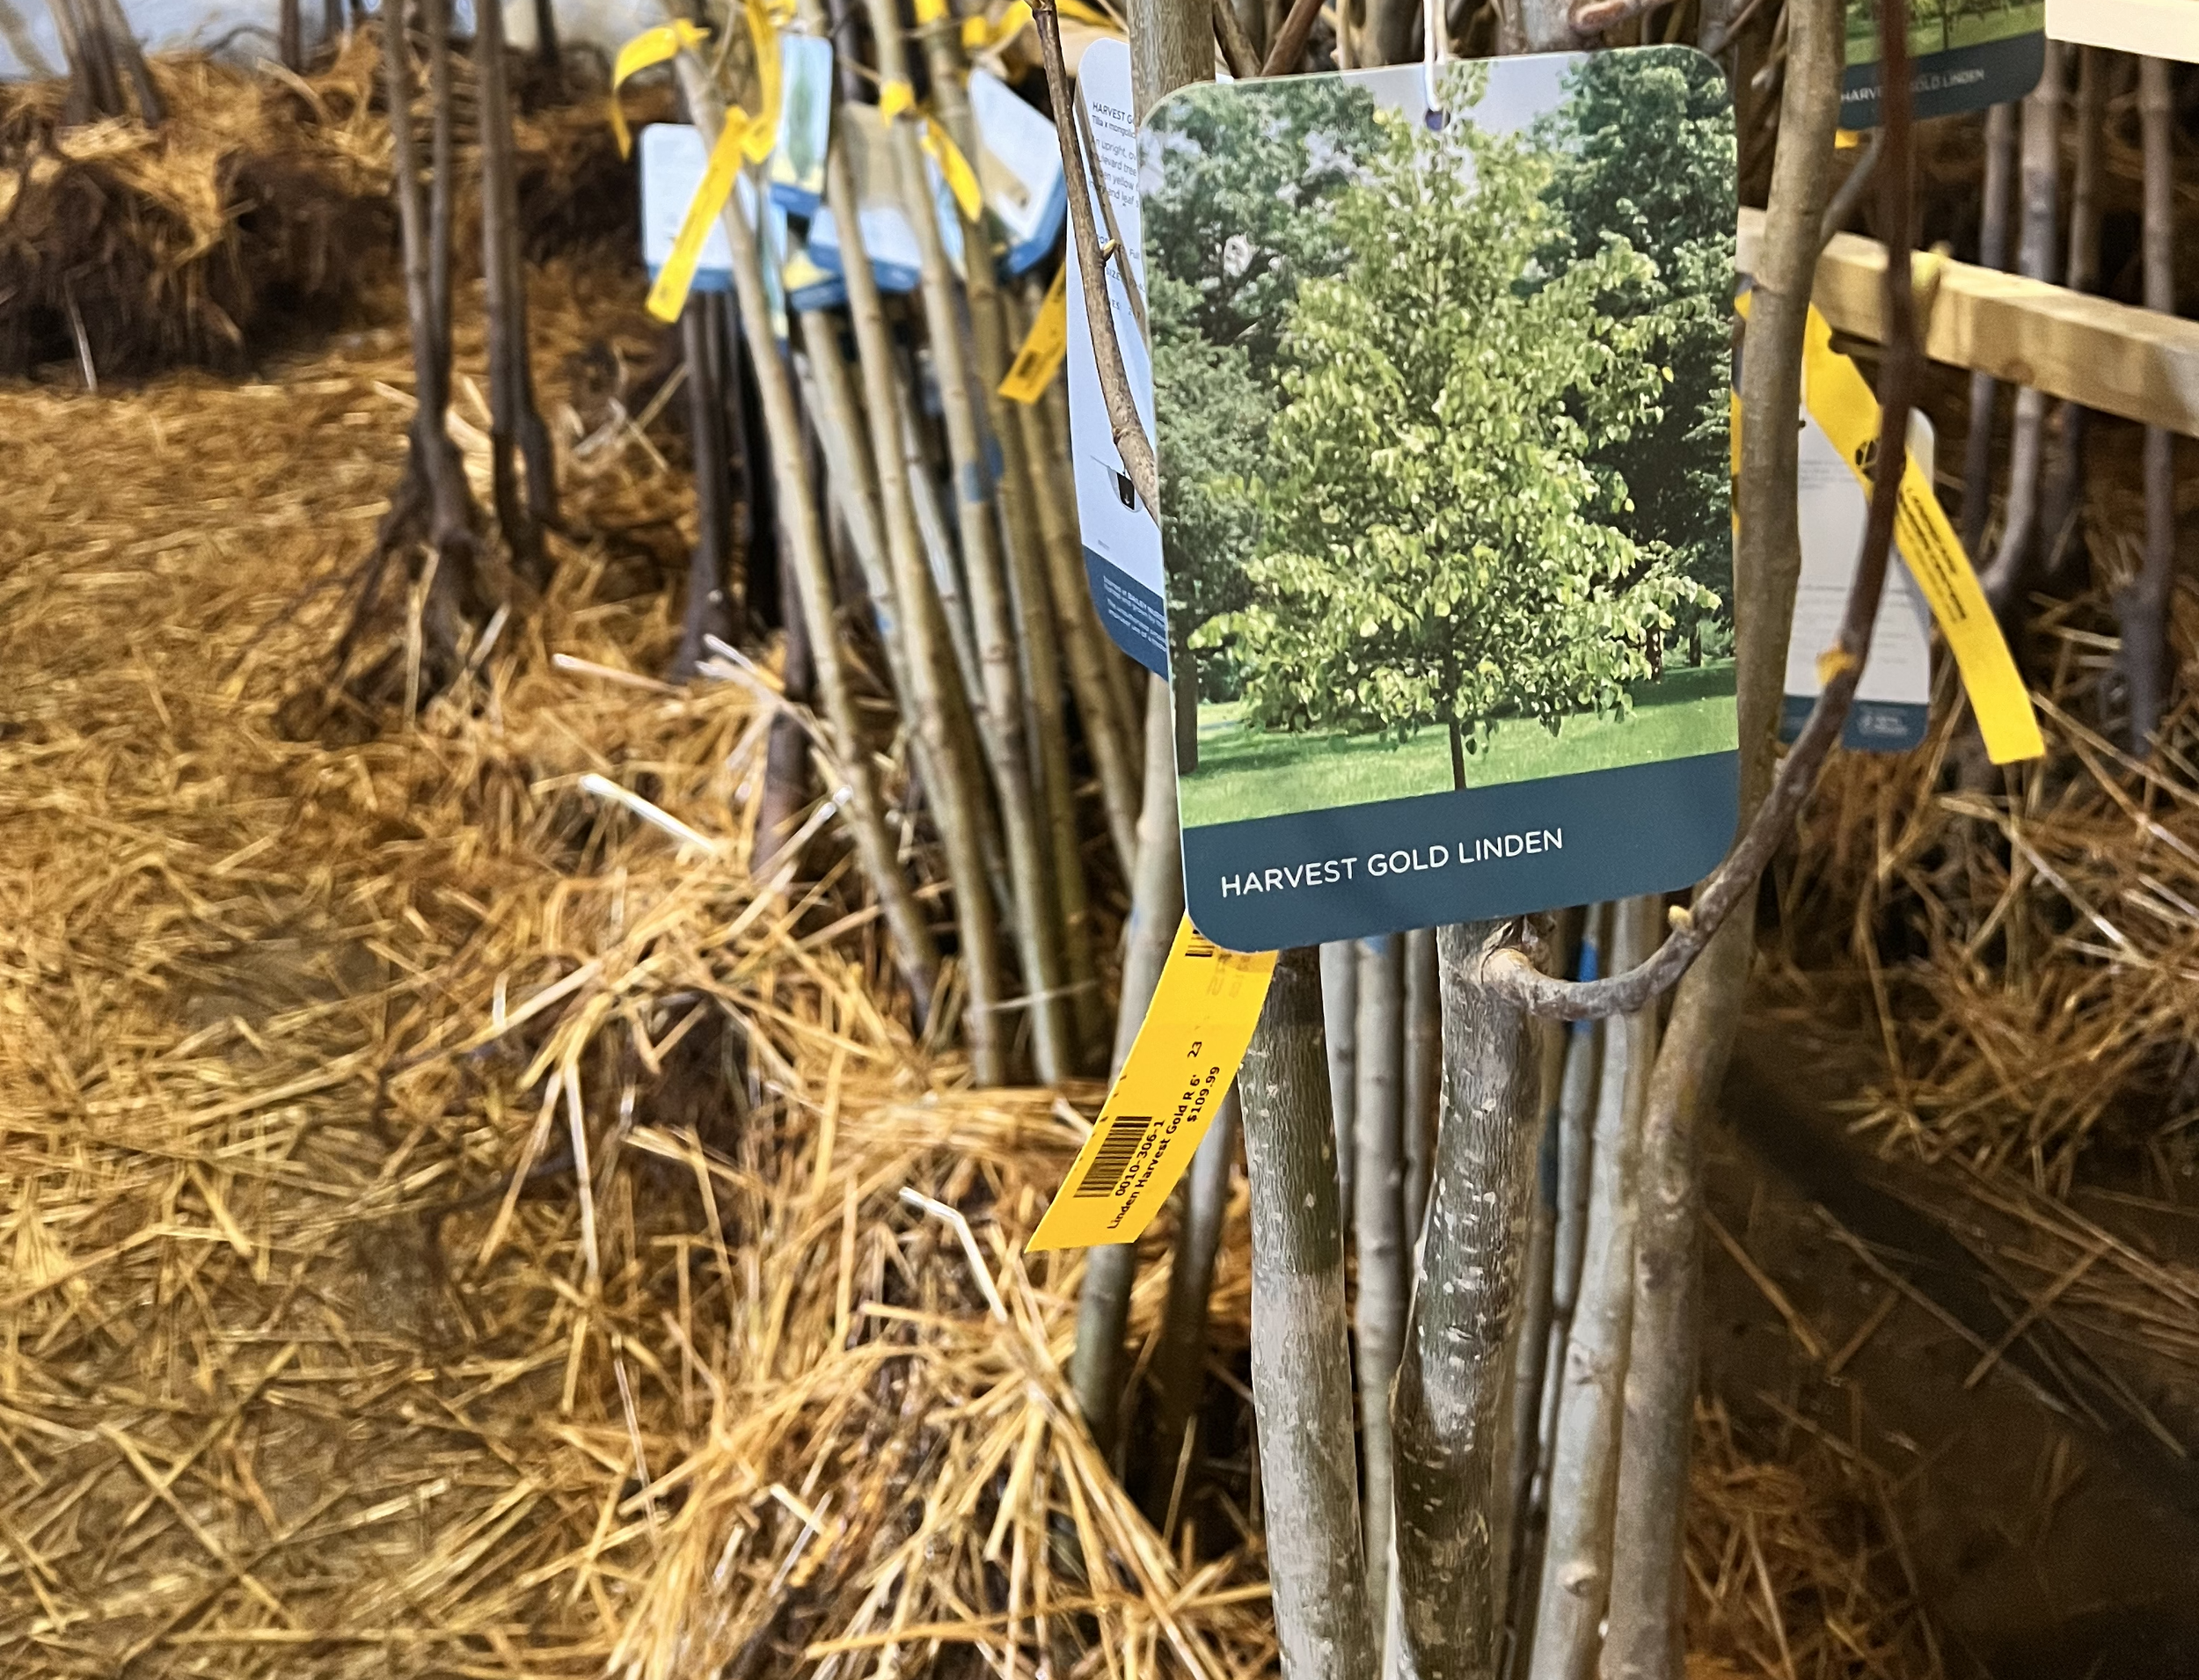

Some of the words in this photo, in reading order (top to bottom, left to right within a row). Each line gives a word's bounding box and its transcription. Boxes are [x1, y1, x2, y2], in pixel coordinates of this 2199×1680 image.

[1092, 101, 1125, 121] HARVEST
[1220, 857, 1357, 898] HARVEST
[1367, 844, 1450, 877] GOLD
[1457, 827, 1564, 865] LINDEN
[1187, 1041, 1202, 1058] 23
[1187, 1065, 1221, 1123] $109.99
[1107, 1190, 1140, 1230] Linden
[1135, 1138, 1171, 1189] Harvest
[1165, 1105, 1187, 1135] Gold
[1183, 1090, 1194, 1100] R
[1115, 1120, 1165, 1197] 0010-306-1
